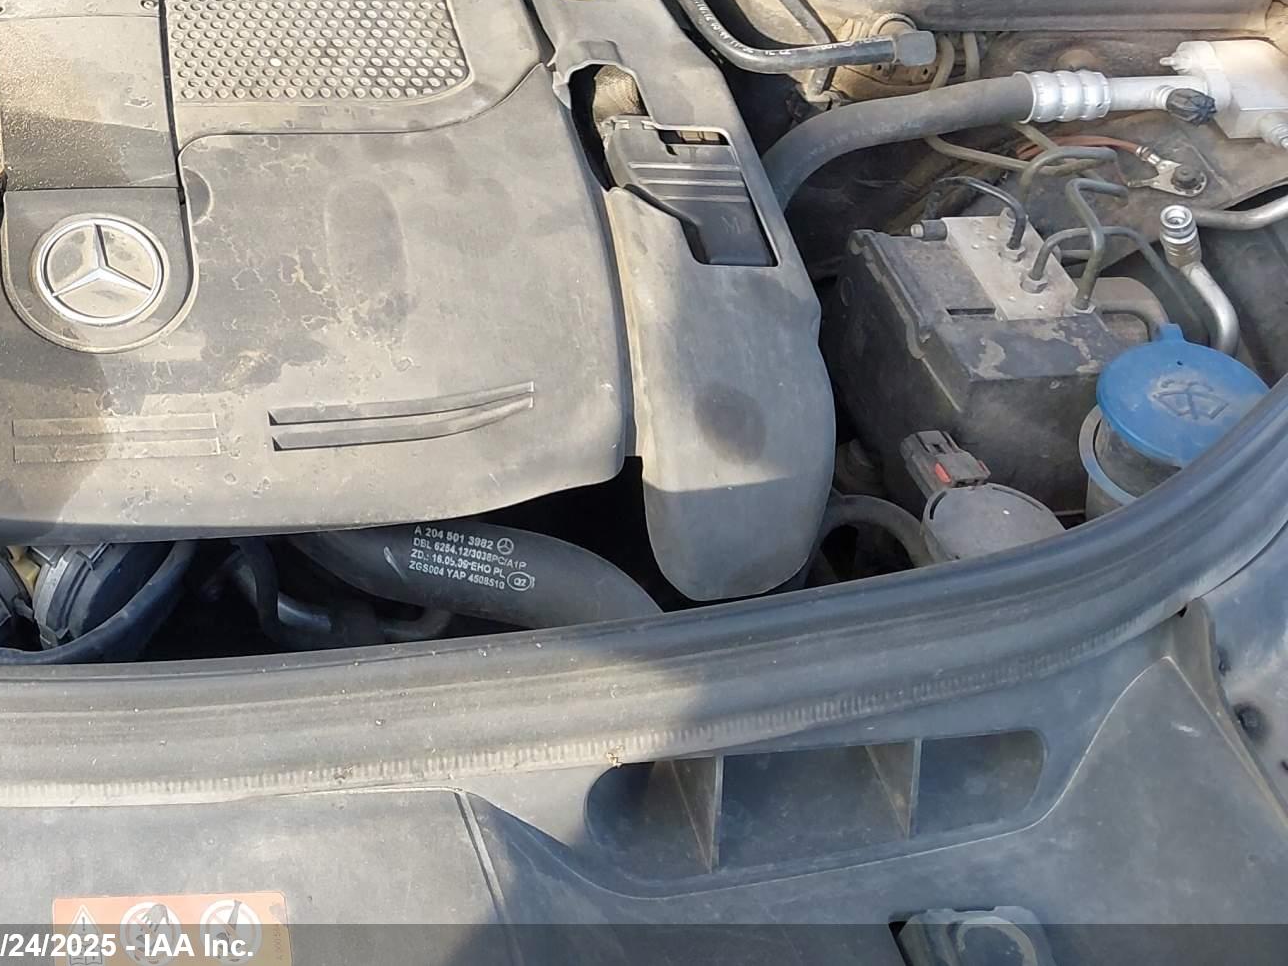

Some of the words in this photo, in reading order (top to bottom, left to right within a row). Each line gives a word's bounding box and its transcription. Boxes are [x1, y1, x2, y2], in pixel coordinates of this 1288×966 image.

[414, 525, 422, 535] A
[426, 527, 444, 539] 204
[446, 530, 465, 543] 501
[413, 537, 432, 550] DBL
[447, 568, 467, 580] YAP
